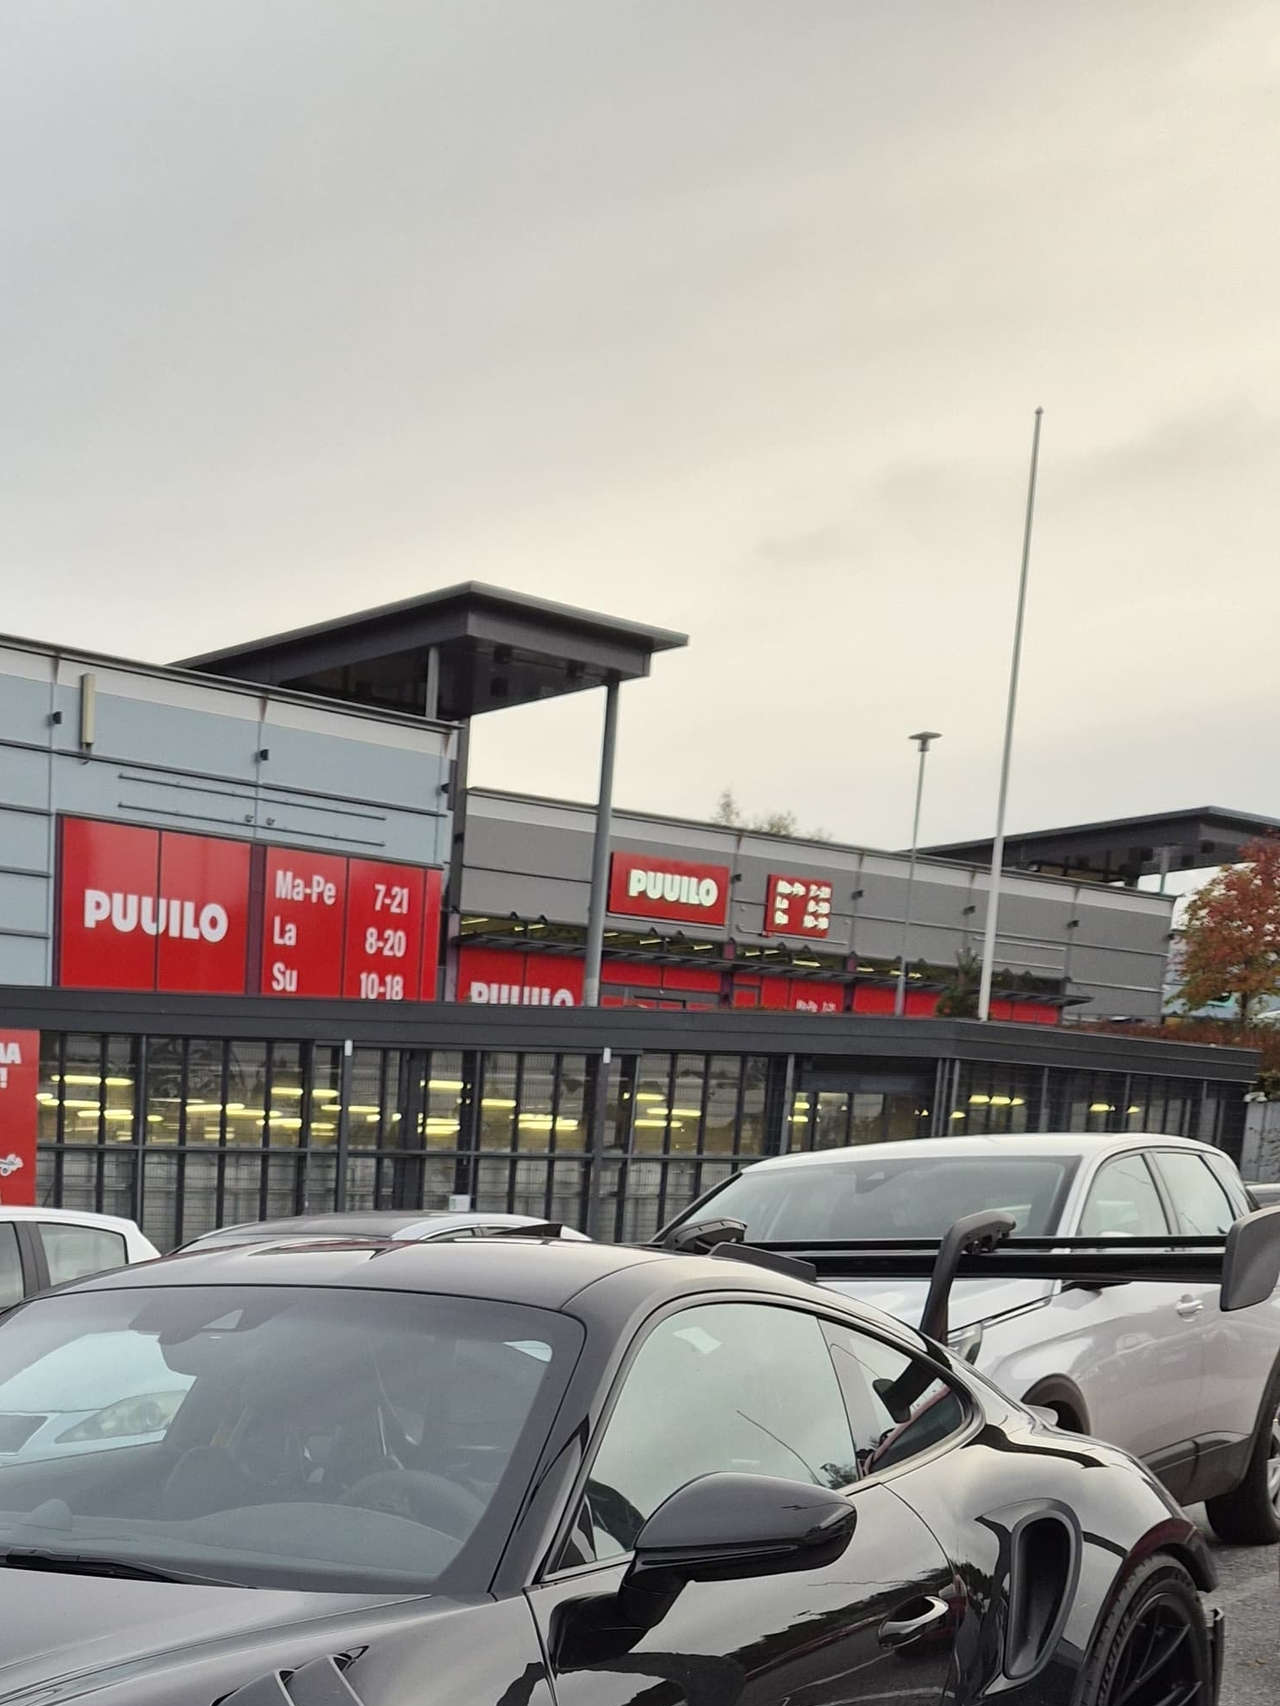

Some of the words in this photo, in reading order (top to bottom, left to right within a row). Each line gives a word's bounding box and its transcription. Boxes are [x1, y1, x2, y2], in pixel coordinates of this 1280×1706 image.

[275, 870, 336, 906] Ma-Pe
[374, 884, 409, 914] 7-21
[628, 868, 718, 907] PUUILO
[84, 888, 228, 943] PUUILO
[273, 915, 297, 946] La
[365, 926, 406, 958] 8-20
[272, 961, 298, 993] Su
[359, 971, 404, 1001] 10-18
